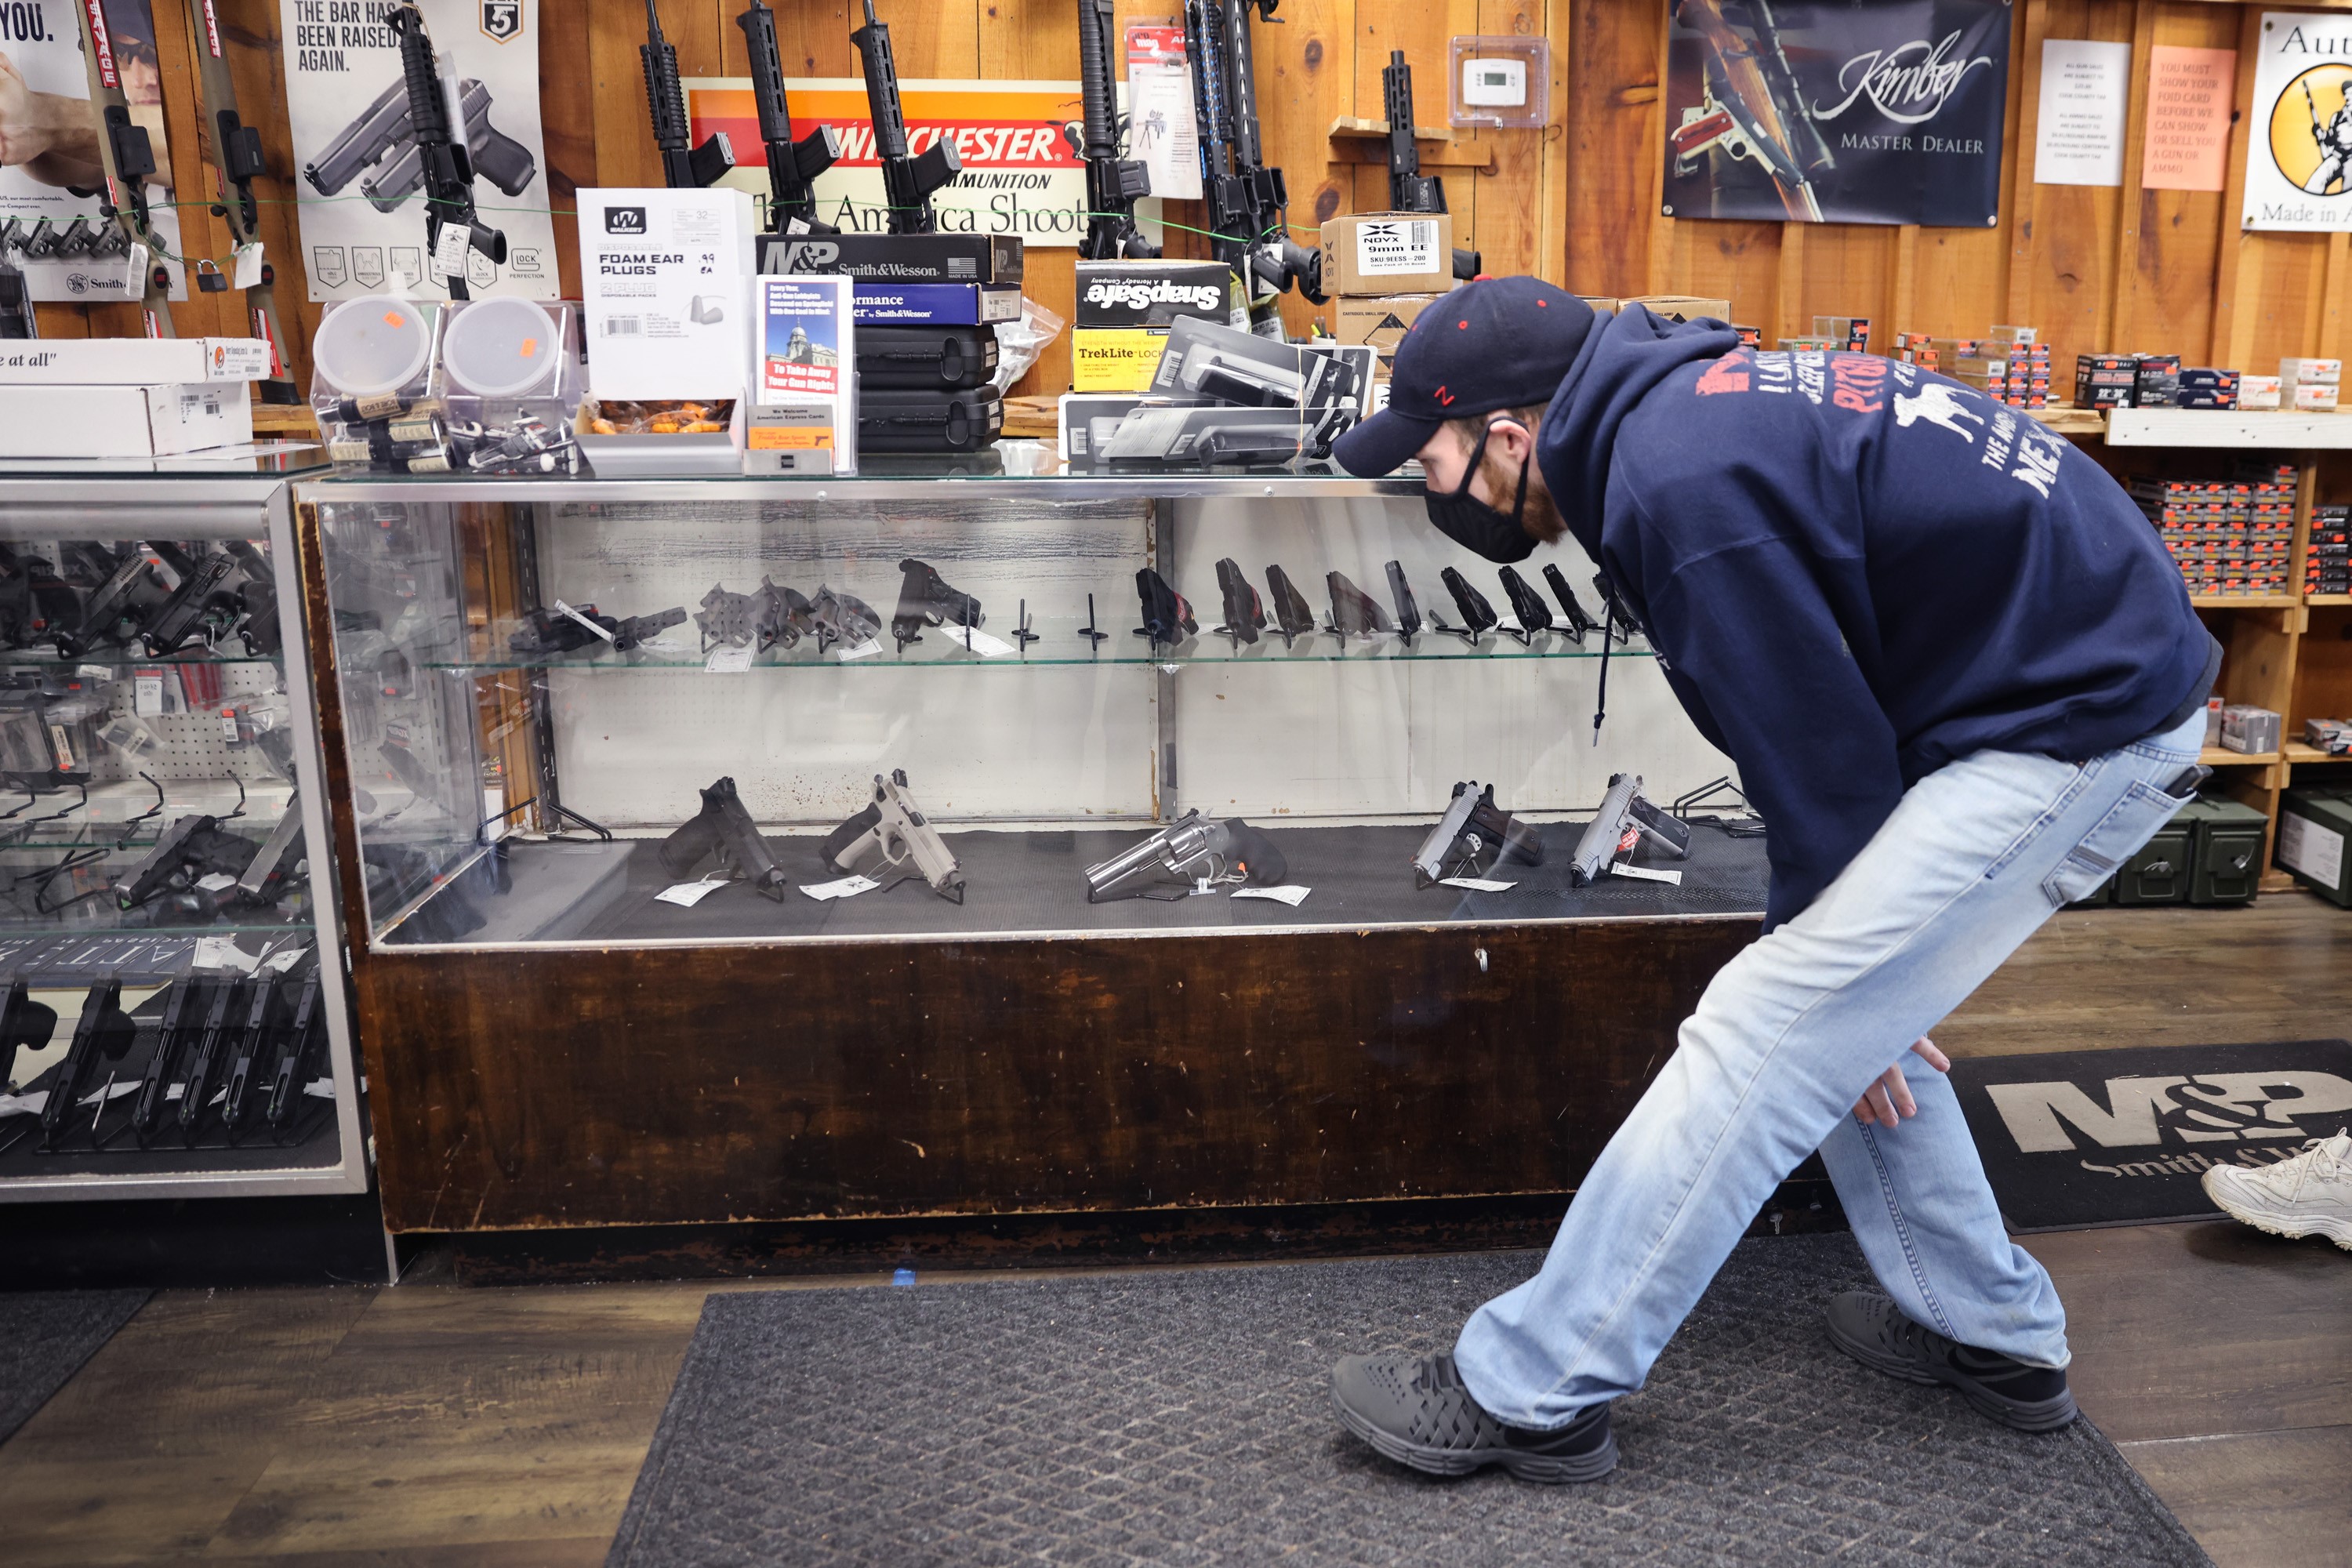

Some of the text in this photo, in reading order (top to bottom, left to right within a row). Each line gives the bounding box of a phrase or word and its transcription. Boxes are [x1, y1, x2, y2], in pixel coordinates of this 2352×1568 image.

[295, 1, 396, 24] THE BAR HAS
[89, 2, 116, 83] SAVAGE
[296, 25, 401, 48] BEEN RAISED.
[298, 49, 350, 71] AGAIN.
[2160, 63, 2211, 74] YOU MUST
[1812, 28, 1994, 124] Kimber
[2158, 77, 2219, 89] SHOW YOUR
[2158, 92, 2211, 103] FOID CARD
[2157, 106, 2214, 118] BEFORE WE
[2154, 120, 2208, 132] CAN SHOW
[832, 126, 1054, 162] WICHESTER
[1842, 132, 1984, 154] MASTER DEALER
[2154, 135, 2216, 146] OR SELL YOU
[2152, 150, 2159, 158] A
[2161, 150, 2183, 159] GUN
[2151, 164, 2183, 174] AMMO
[944, 173, 1051, 189] MMUNITION
[834, 194, 975, 233] Amica
[2262, 203, 2336, 223] Made in
[599, 254, 684, 263] FOAM EAR
[601, 266, 656, 274] PLUGS
[614, 283, 656, 292] PLUG
[1091, 277, 1121, 285] Company
[853, 295, 904, 306] ormance
[1087, 280, 1221, 310] SnapSafe
[9, 354, 25, 366] at
[774, 364, 831, 379] To Take Away
[768, 376, 835, 390] Your Gun Rights
[1981, 436, 2010, 471] THE
[1985, 1070, 2352, 1154] M&P
